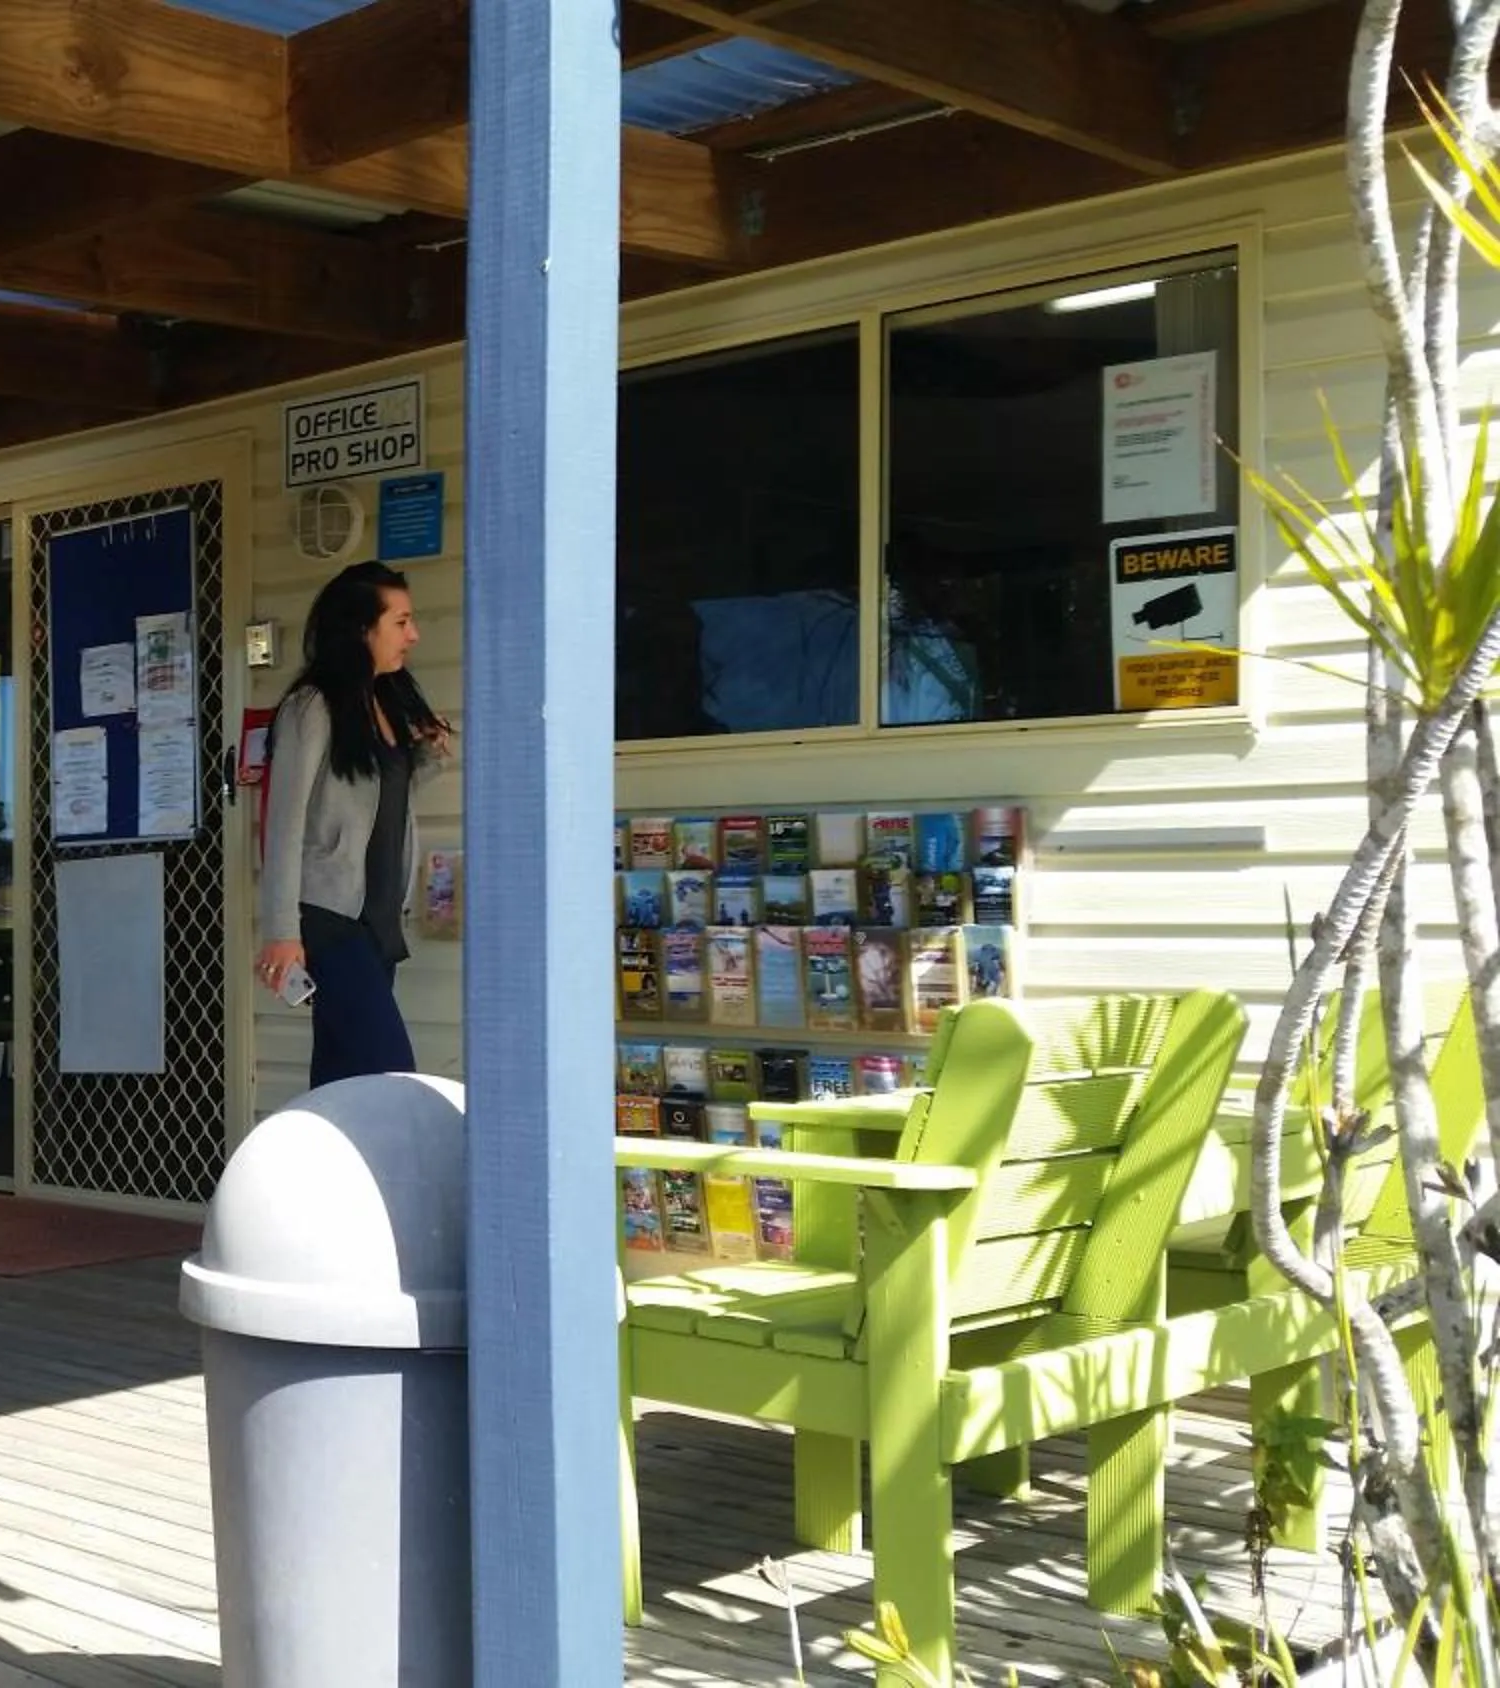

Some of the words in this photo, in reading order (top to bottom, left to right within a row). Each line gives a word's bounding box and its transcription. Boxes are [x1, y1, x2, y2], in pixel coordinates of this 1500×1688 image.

[295, 402, 378, 438] OFFICE
[291, 447, 339, 477] PRO
[348, 433, 416, 467] SHOP
[1123, 543, 1229, 575] BEWARE
[813, 1079, 852, 1094] FREE
